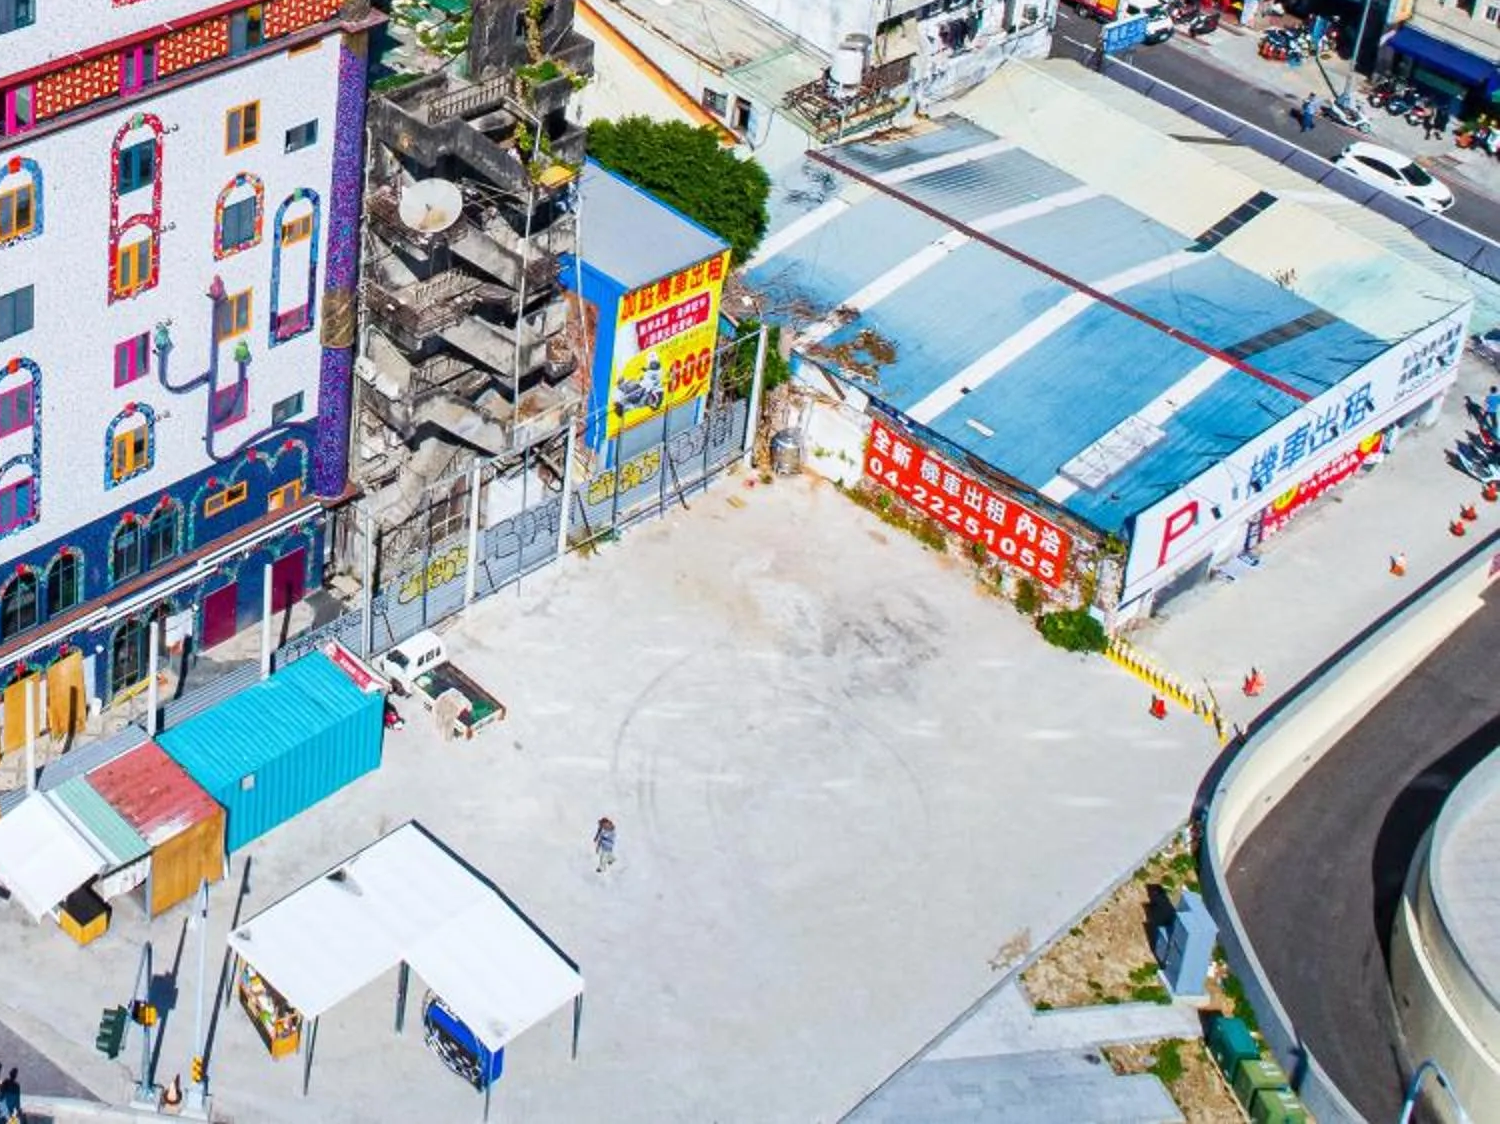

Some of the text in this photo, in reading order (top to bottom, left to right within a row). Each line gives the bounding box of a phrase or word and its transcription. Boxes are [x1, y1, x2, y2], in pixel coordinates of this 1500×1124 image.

[872, 427, 913, 470] 全新
[1249, 381, 1375, 492] 機車出租
[869, 457, 1057, 578] 04-22251055
[1156, 499, 1199, 569] P
